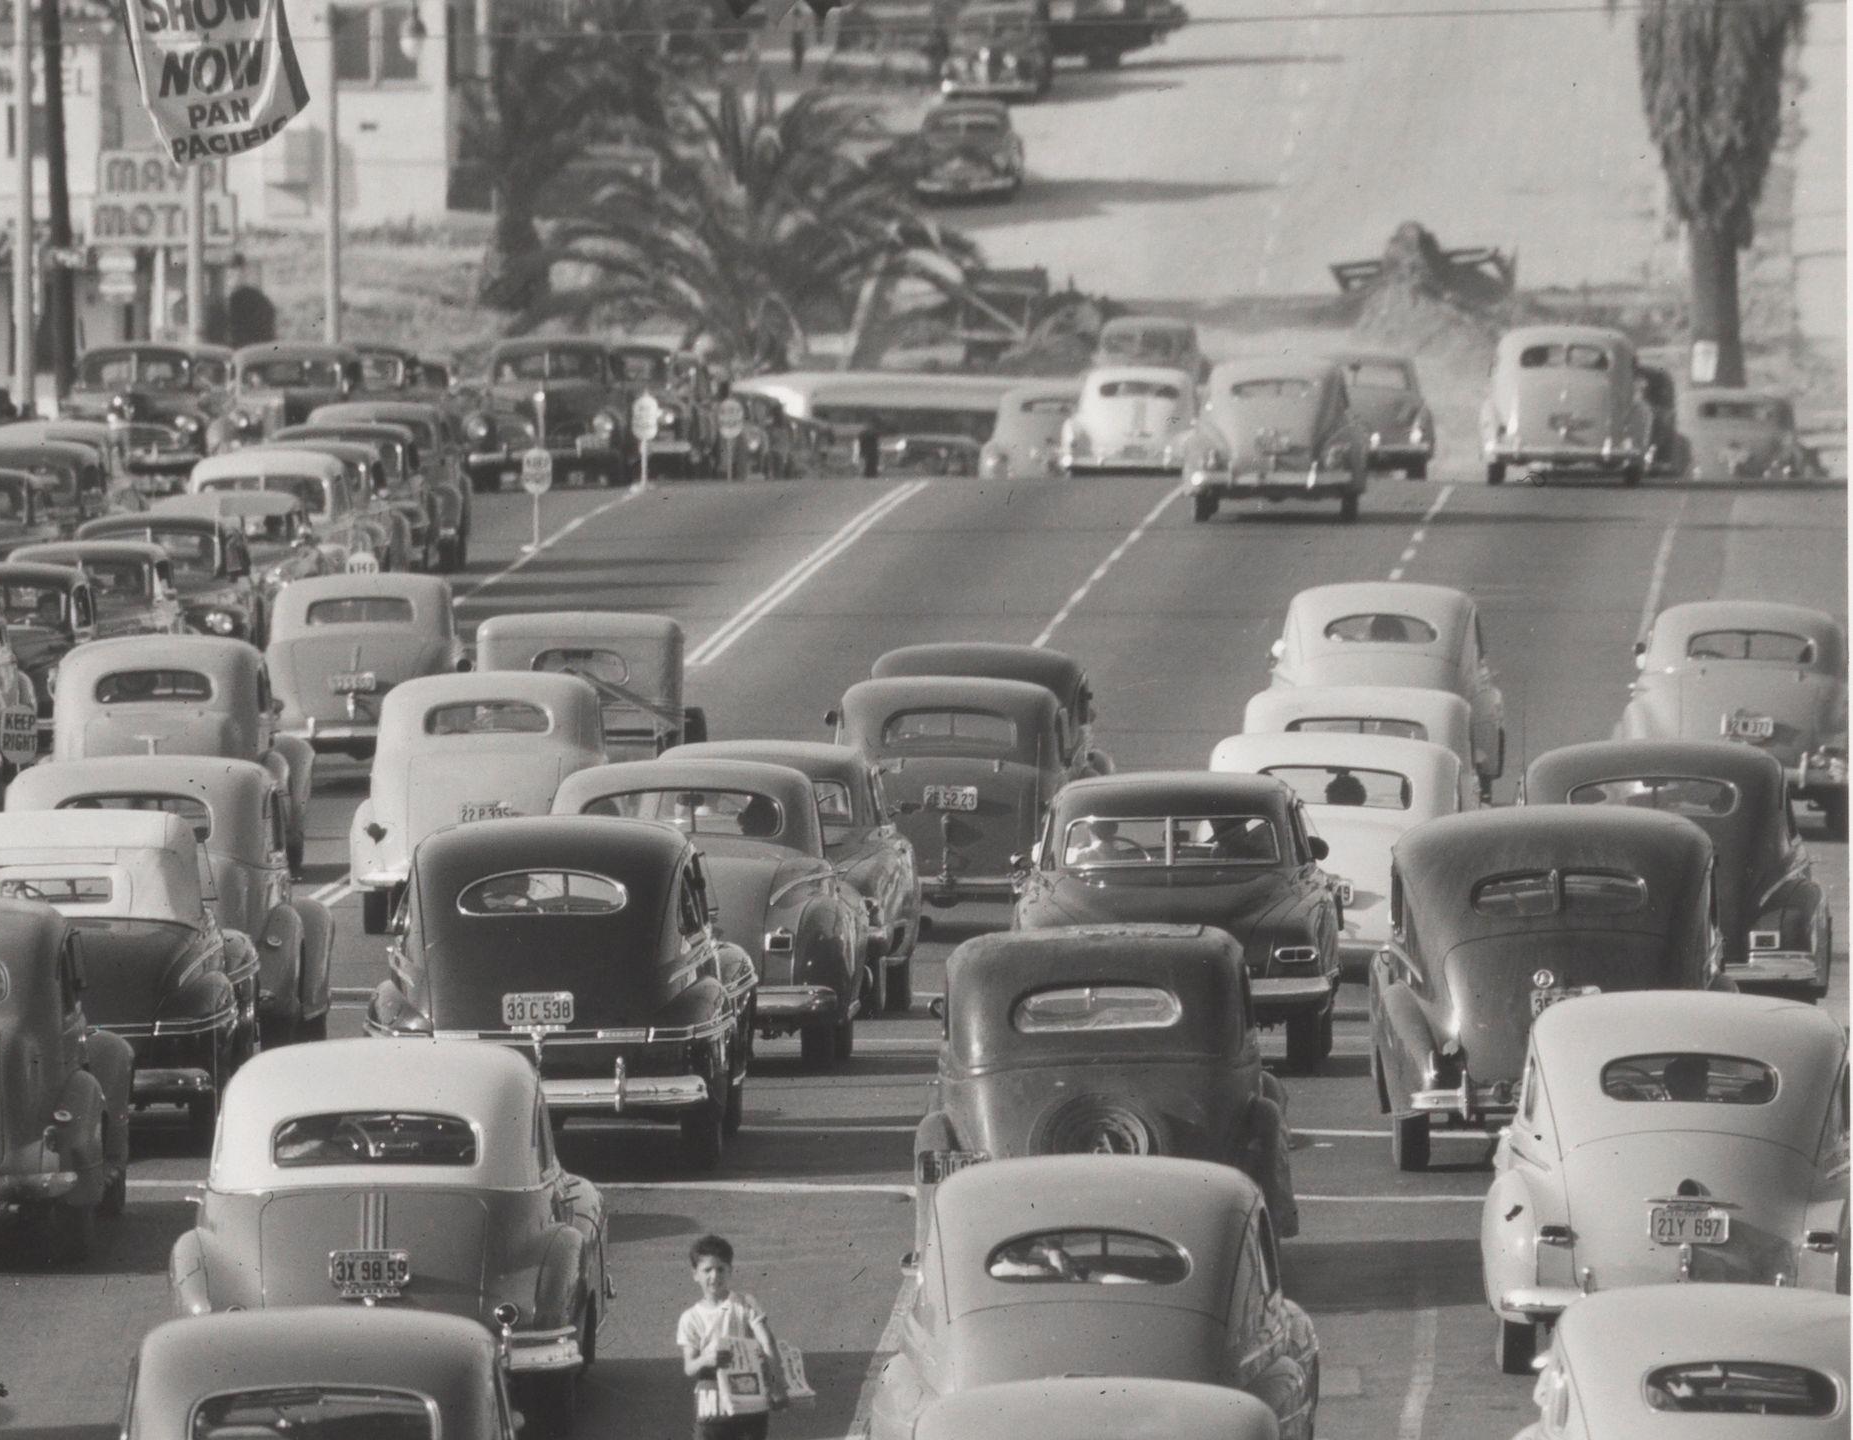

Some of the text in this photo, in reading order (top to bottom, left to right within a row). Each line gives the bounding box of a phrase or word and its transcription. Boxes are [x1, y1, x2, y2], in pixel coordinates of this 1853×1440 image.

[143, 0, 260, 32] SHOW
[159, 39, 264, 98] NOW
[187, 97, 250, 129] PAN
[5, 713, 35, 731] KEEP
[2, 732, 37, 752] RIGHT
[507, 1000, 571, 1020] 33 C 538
[1694, 1218, 1722, 1238] 697
[336, 1259, 408, 1282] 3X 98 59
